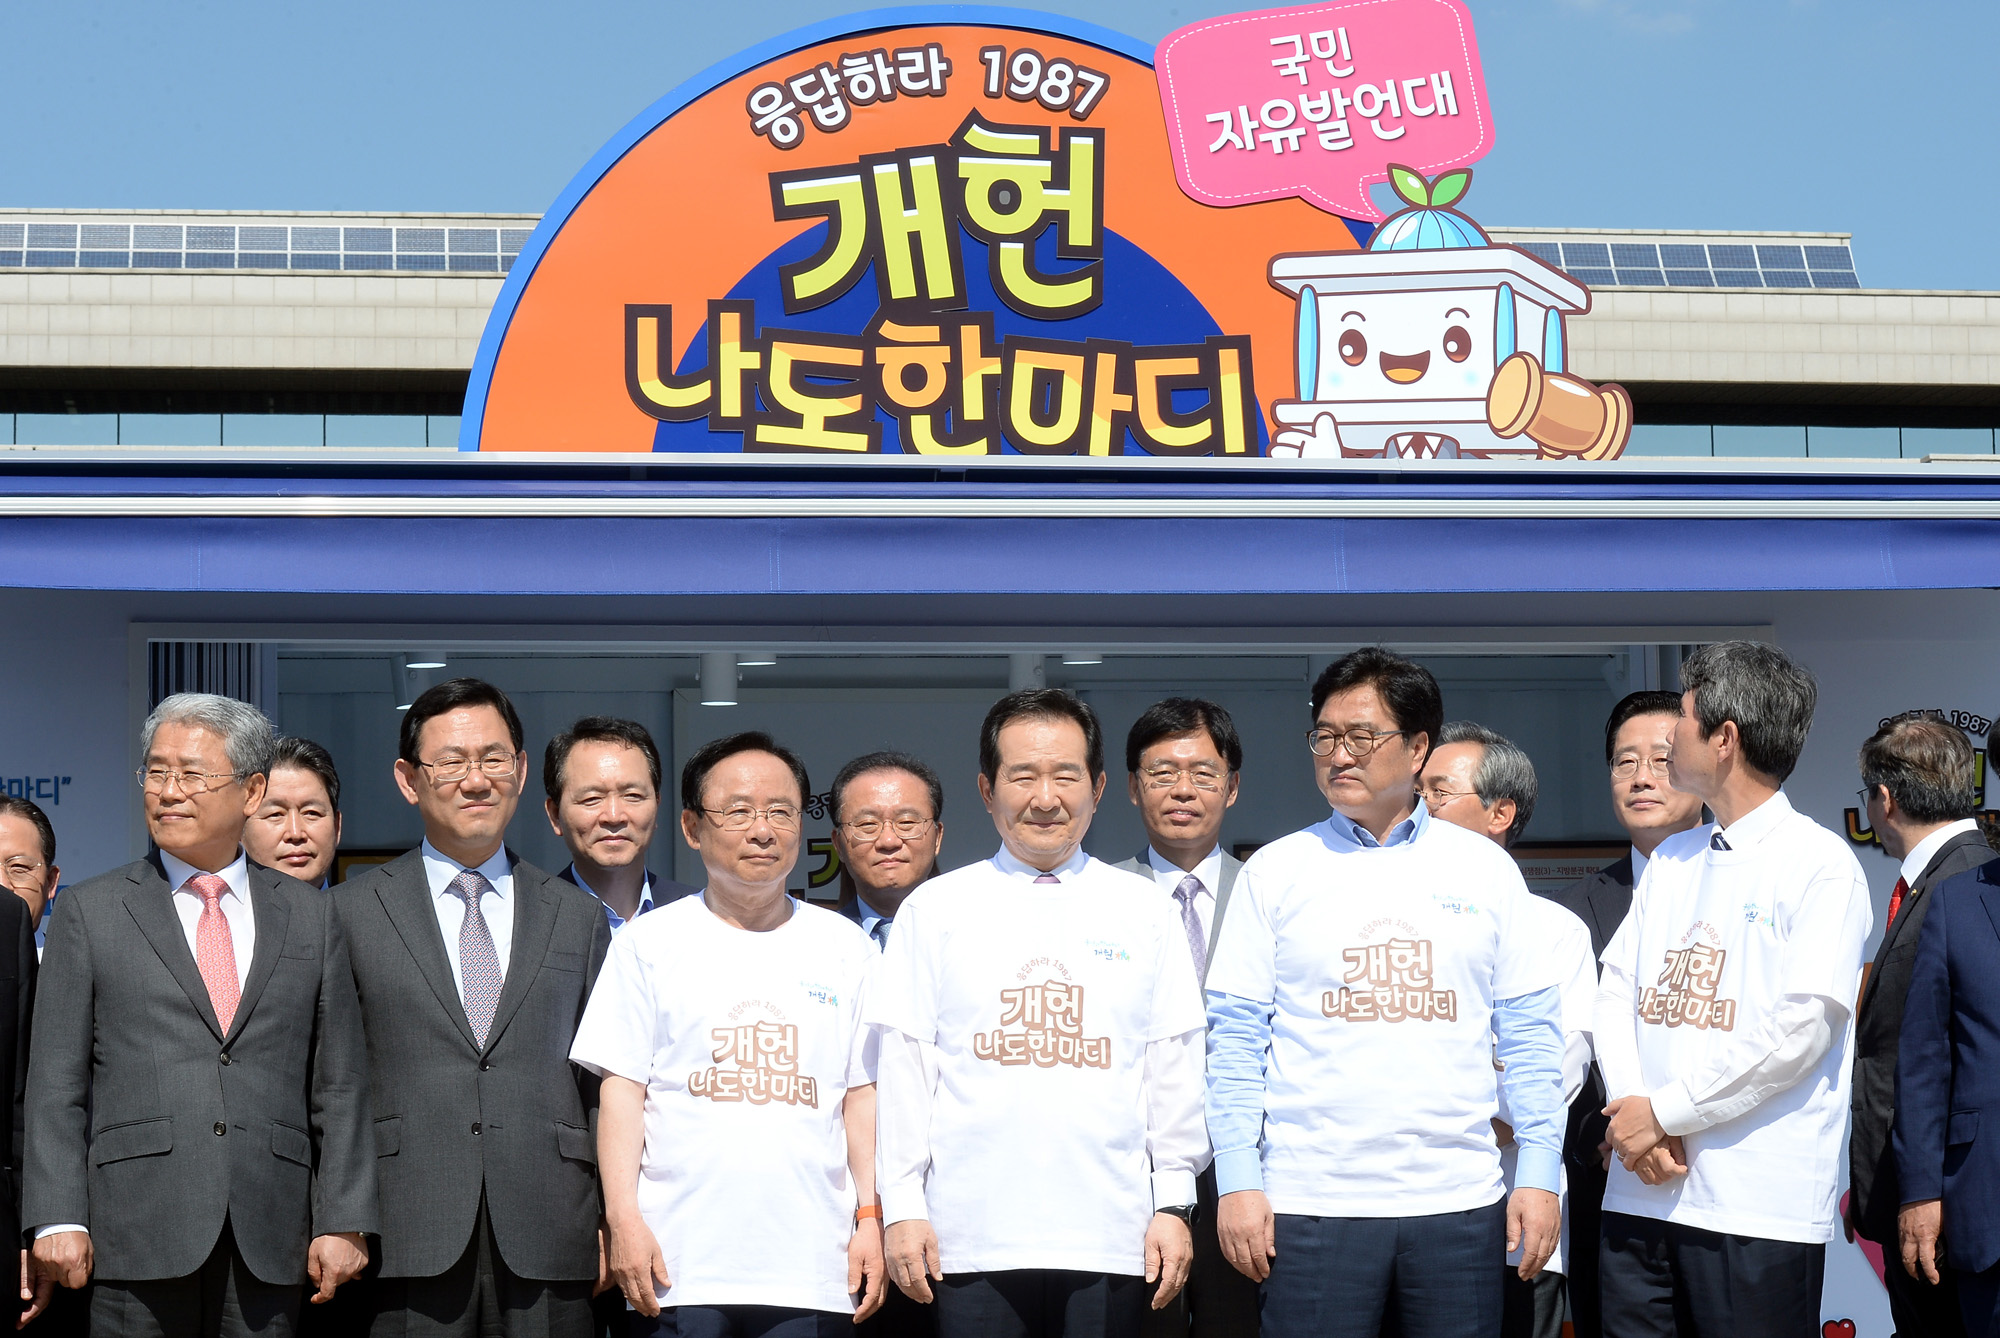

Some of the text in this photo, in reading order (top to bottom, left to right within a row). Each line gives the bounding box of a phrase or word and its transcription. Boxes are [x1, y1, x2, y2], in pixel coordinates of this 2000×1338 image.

[1269, 27, 1356, 85] 국민
[750, 46, 1108, 146] 응답하라 1987
[1205, 70, 1460, 154] 자유발언대
[778, 118, 1098, 311] 개헌
[1950, 710, 1992, 735] 1987
[0, 776, 72, 806] 마디”
[1358, 917, 1419, 940] 응답하라 1987
[1703, 922, 1721, 946] 1987
[1016, 956, 1072, 981] 응답하라 1987
[1344, 938, 1431, 989] 개헌
[1659, 943, 1726, 997] 개헌
[727, 999, 786, 1021] 응답하라 1987
[1002, 980, 1081, 1034] 개헌
[1322, 985, 1456, 1021] 나도한마디
[712, 1021, 796, 1073] 개헌
[974, 1029, 1110, 1067] 나도한마디
[689, 1068, 818, 1107] 나도한마디
